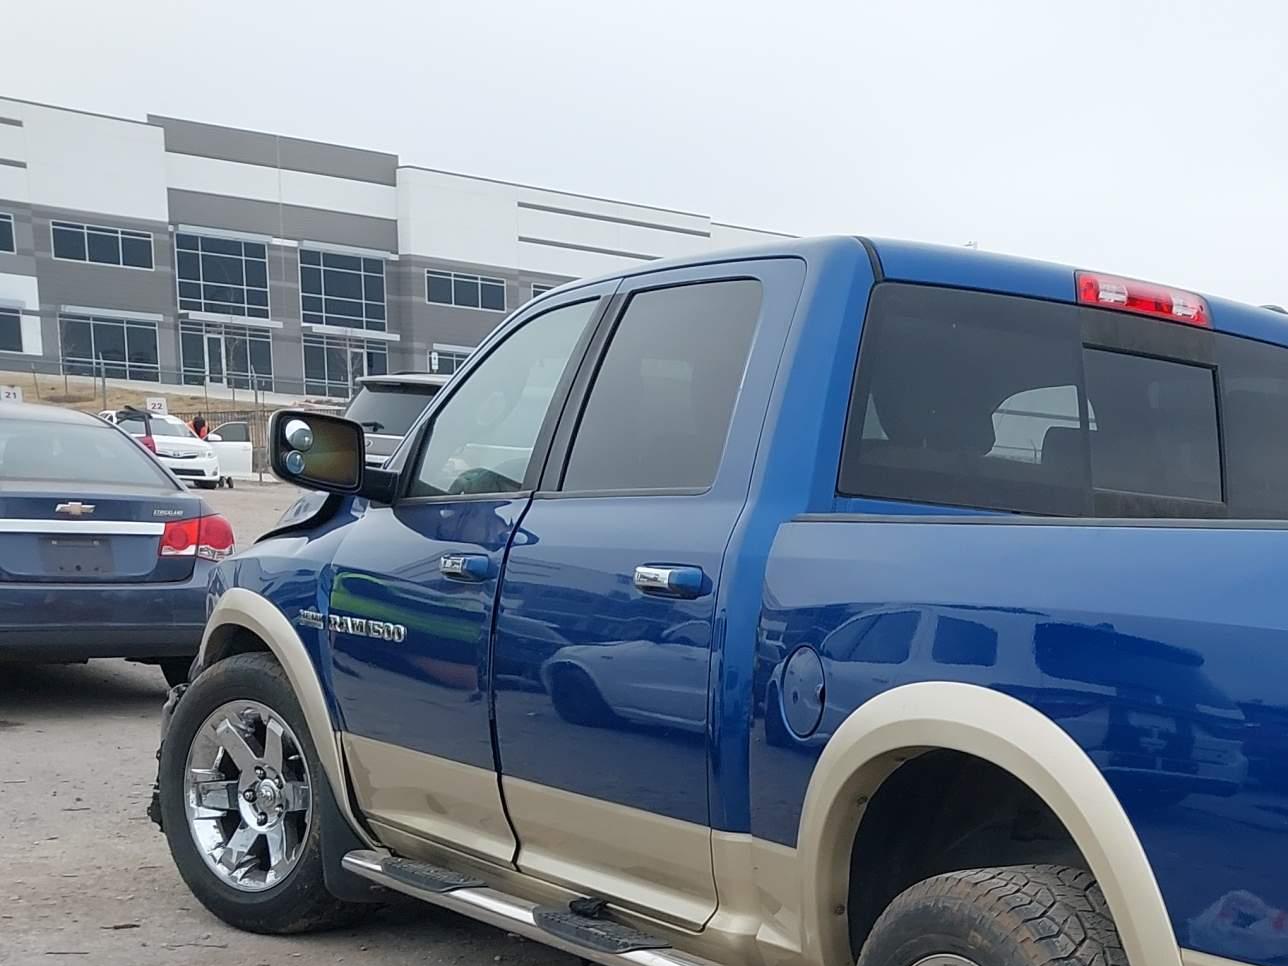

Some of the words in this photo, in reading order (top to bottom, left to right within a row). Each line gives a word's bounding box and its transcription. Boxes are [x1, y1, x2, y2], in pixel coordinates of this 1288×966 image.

[4, 391, 17, 400] 21
[150, 402, 163, 410] 22
[328, 614, 367, 636] RAM
[367, 619, 407, 642] 1500
